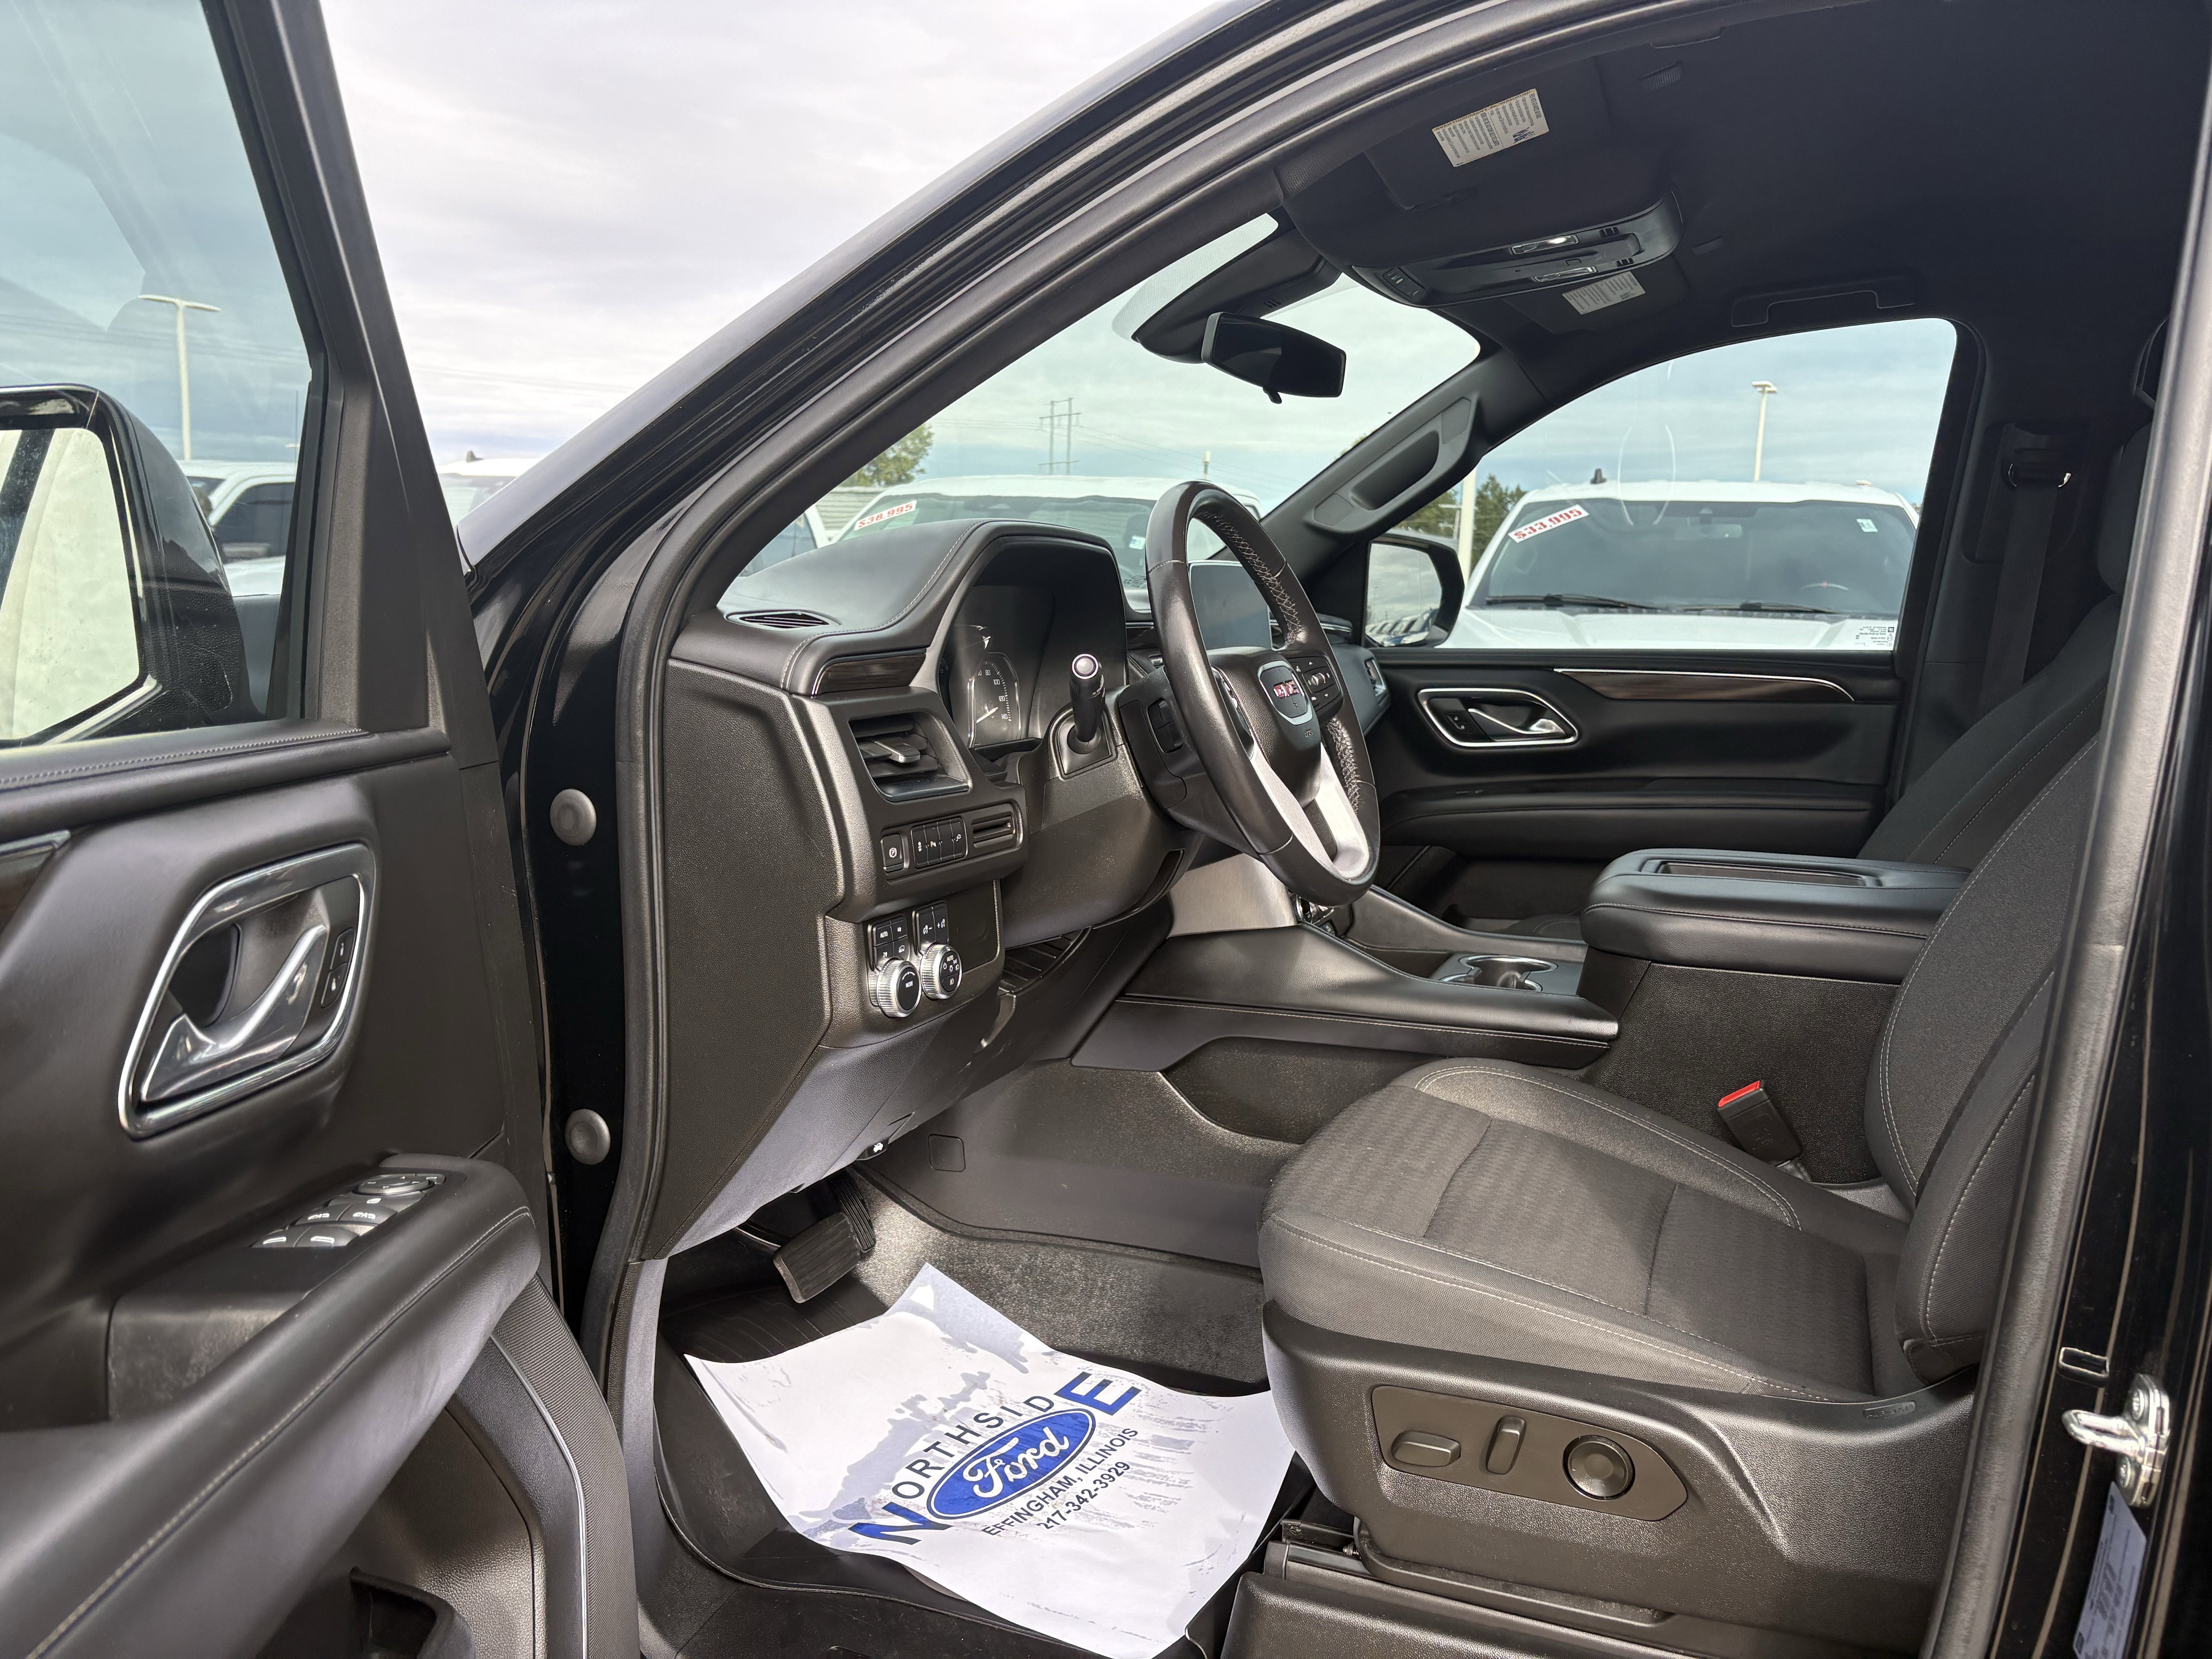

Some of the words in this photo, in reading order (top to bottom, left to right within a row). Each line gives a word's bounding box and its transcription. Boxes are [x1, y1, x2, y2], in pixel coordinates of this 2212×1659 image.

[848, 1371, 1142, 1545] NORTHSIDE
[963, 1426, 1069, 1498] Ford
[981, 1475, 1083, 1536] EFFINGHAM,
[1075, 1428, 1139, 1474] ILLINOIS
[1036, 1461, 1130, 1530] 217-342-3929
